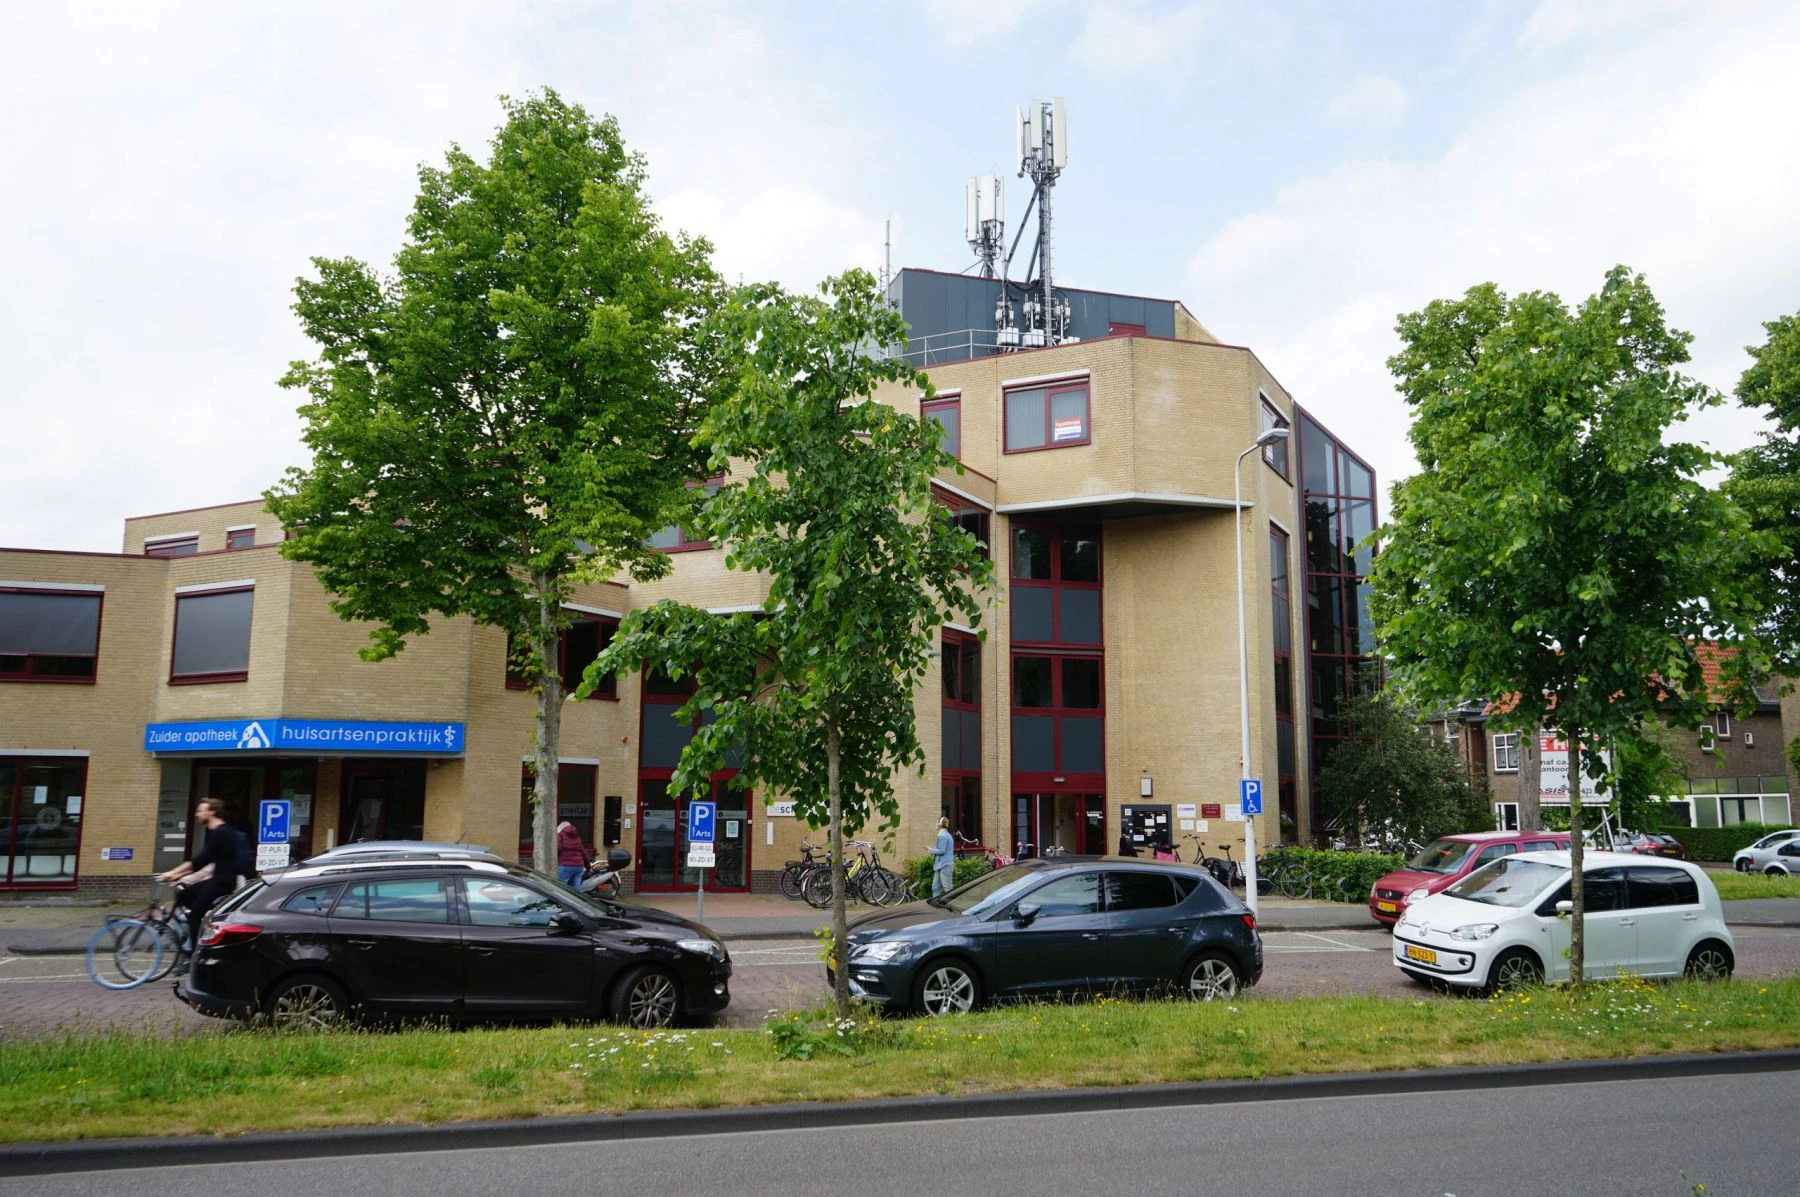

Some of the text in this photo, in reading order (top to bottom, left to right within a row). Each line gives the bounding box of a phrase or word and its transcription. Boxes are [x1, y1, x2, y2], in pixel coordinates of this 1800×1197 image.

[149, 729, 238, 744] Zuider apotheek
[282, 726, 441, 745] huisartsenpraktijk
[1245, 782, 1258, 800] P
[266, 804, 284, 826] P
[695, 805, 710, 826] P
[696, 830, 711, 838] Arts
